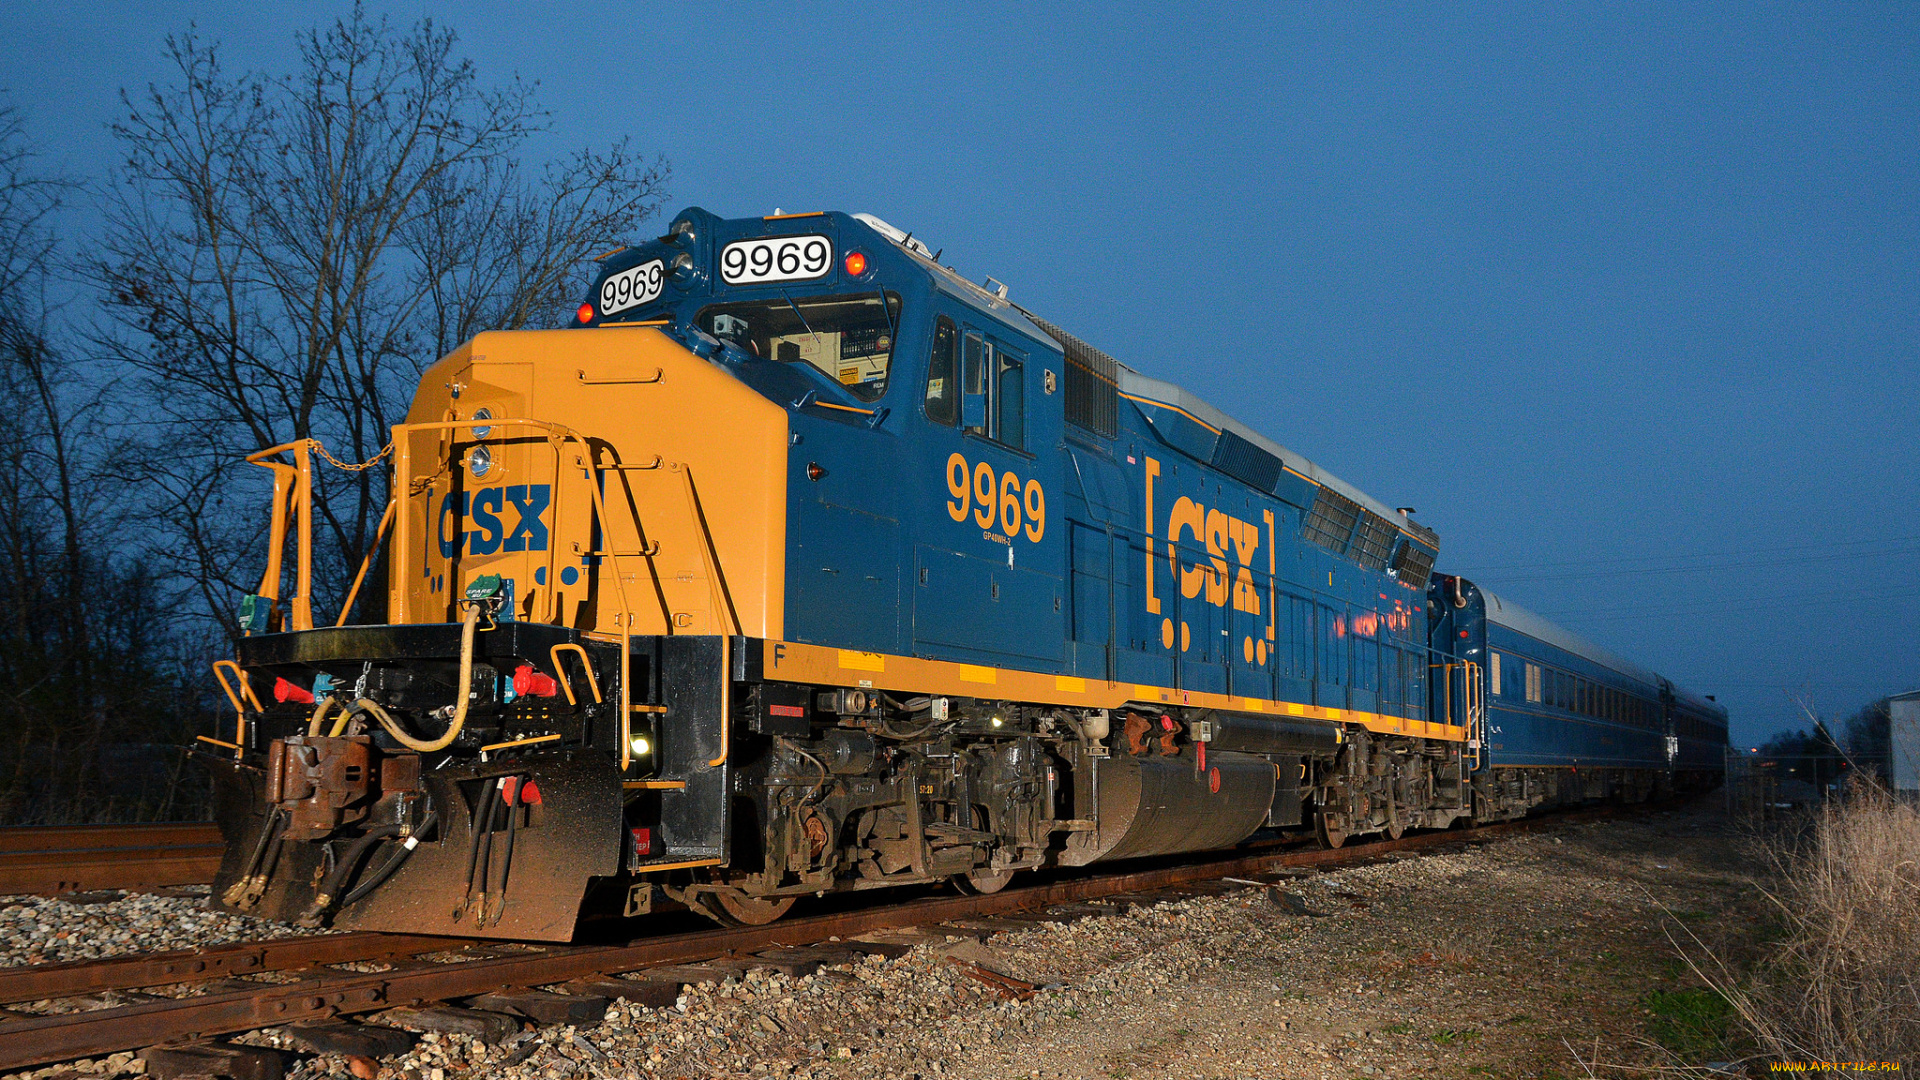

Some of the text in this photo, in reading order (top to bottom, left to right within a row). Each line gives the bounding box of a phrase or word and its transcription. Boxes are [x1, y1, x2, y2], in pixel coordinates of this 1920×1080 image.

[723, 240, 827, 279] 9969
[603, 264, 663, 311] 9969
[946, 452, 1045, 543] 9969
[438, 484, 551, 559] CSX
[1168, 496, 1260, 615] CSX
[774, 643, 786, 669] F
[635, 843, 647, 851] TEP
